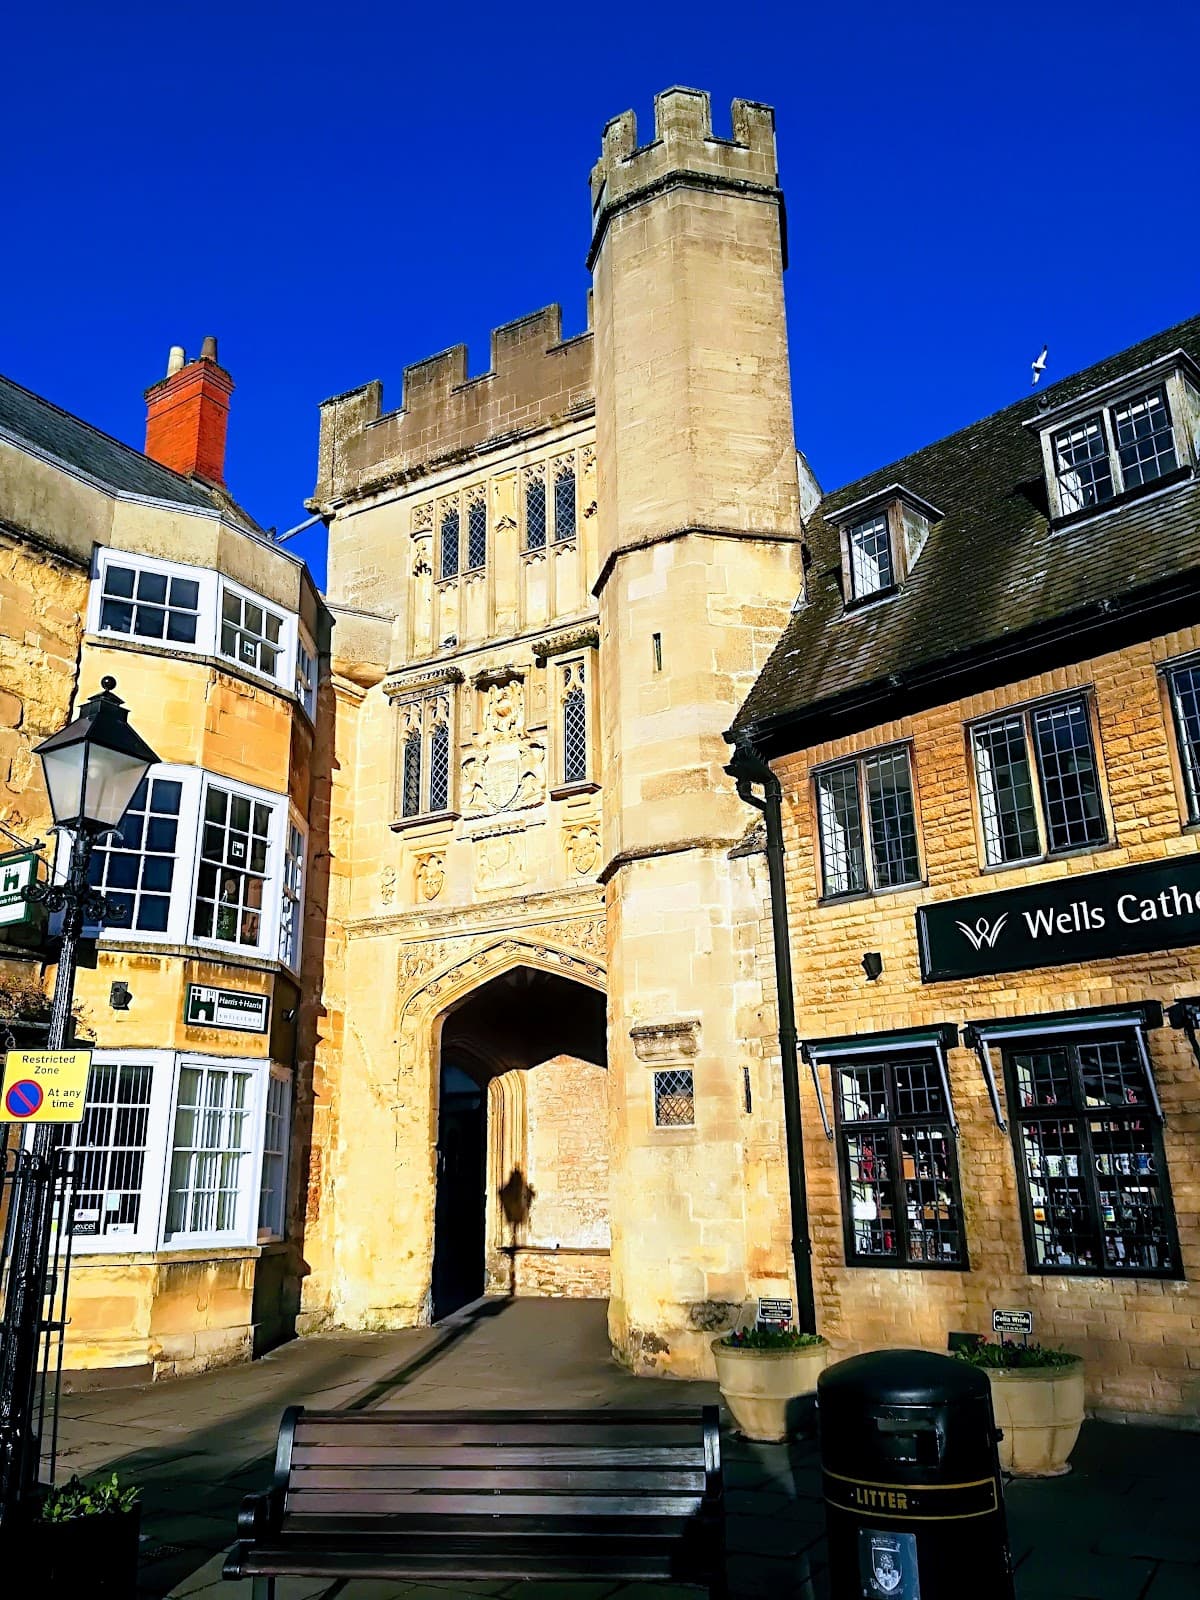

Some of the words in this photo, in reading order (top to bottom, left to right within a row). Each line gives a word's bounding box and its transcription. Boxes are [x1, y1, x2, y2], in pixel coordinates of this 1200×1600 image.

[1021, 901, 1105, 938] Wells
[218, 996, 238, 1006] Harris
[243, 1000, 262, 1010] Harris
[22, 1055, 76, 1064] Restricted
[34, 1065, 60, 1075] Zone
[47, 1088, 60, 1097] At
[63, 1090, 82, 1098] any
[52, 1100, 74, 1108] time
[856, 1488, 908, 1509] LITTER
